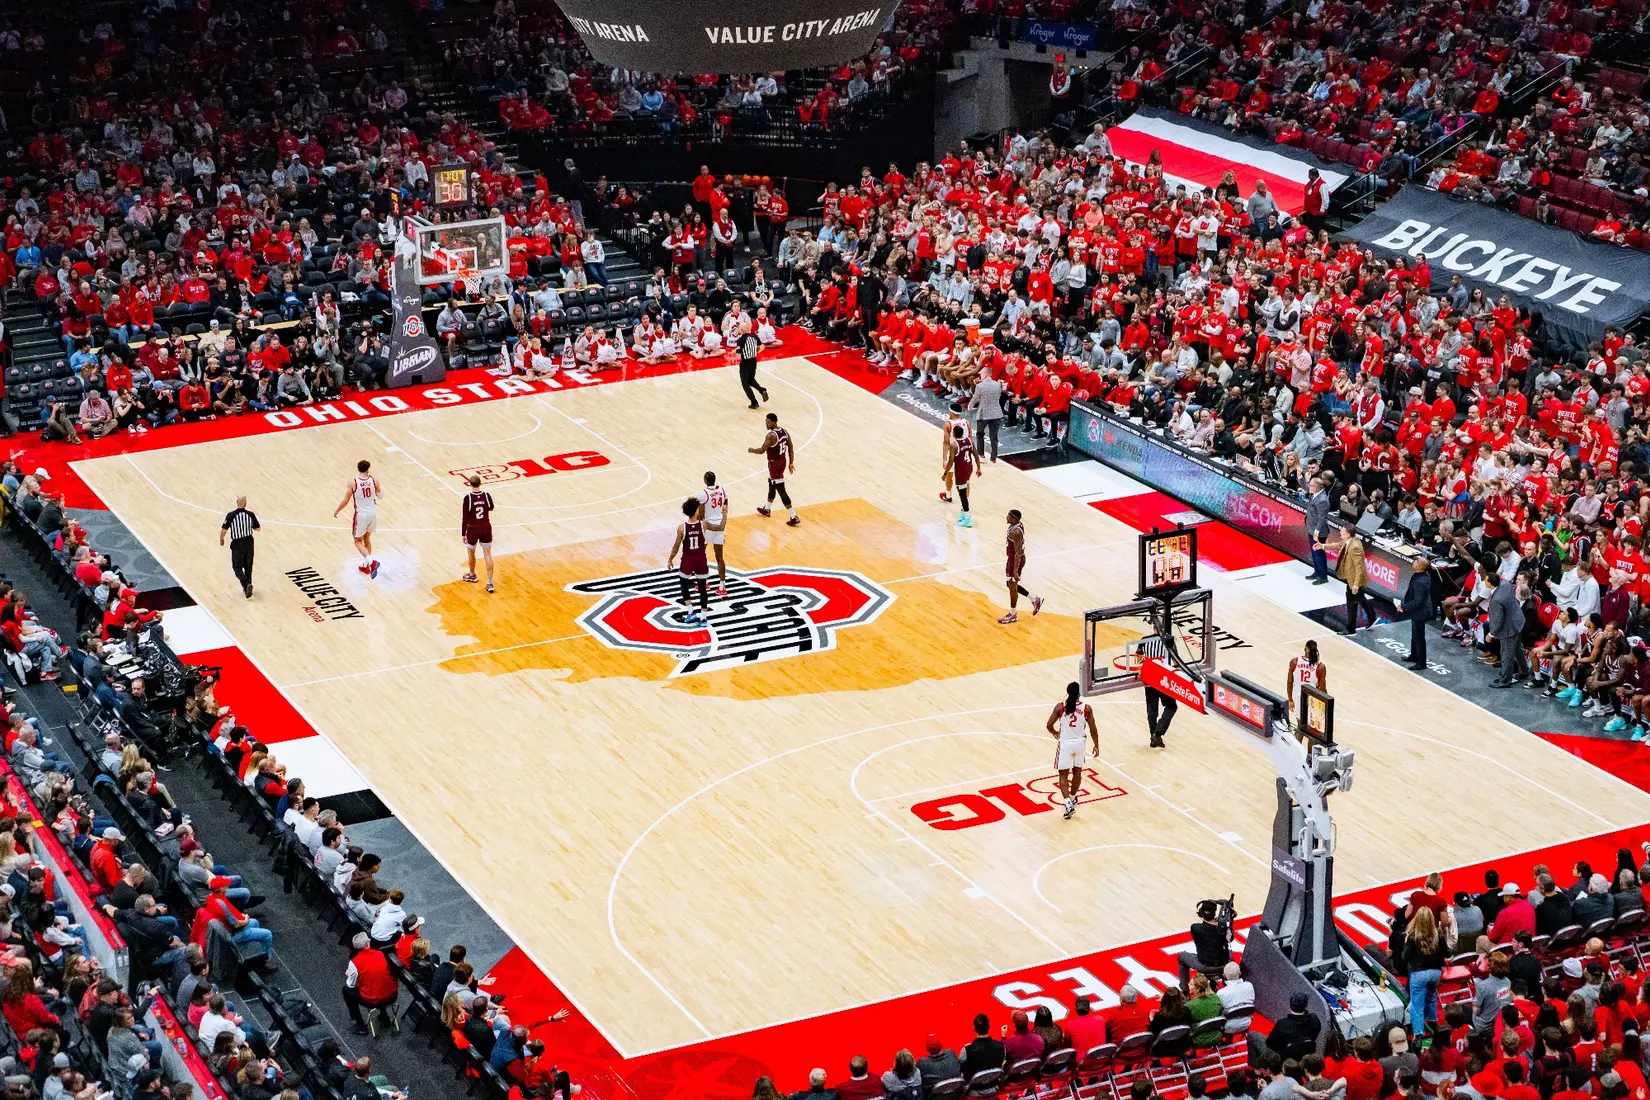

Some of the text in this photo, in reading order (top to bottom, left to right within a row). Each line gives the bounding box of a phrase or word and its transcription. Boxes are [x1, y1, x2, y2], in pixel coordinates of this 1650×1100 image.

[593, 21, 650, 42] ARENA
[705, 8, 881, 44] VALUE CITY ARENA
[1029, 23, 1090, 46] Kroger Kroger
[441, 183, 463, 203] 30
[1372, 219, 1622, 314] BUCKEYE
[393, 349, 437, 377] LIBMAN
[264, 395, 408, 428] OHIO
[779, 441, 787, 455] 15
[964, 451, 971, 462] 4
[362, 487, 372, 498] 10
[711, 497, 723, 509] 34
[475, 506, 484, 520] 2
[689, 536, 699, 550] 11
[285, 566, 364, 620] VALUE CITY
[302, 606, 325, 623] Arena
[1300, 669, 1311, 683] 12
[1068, 713, 1078, 728] 2
[1272, 859, 1305, 886] Safelite
